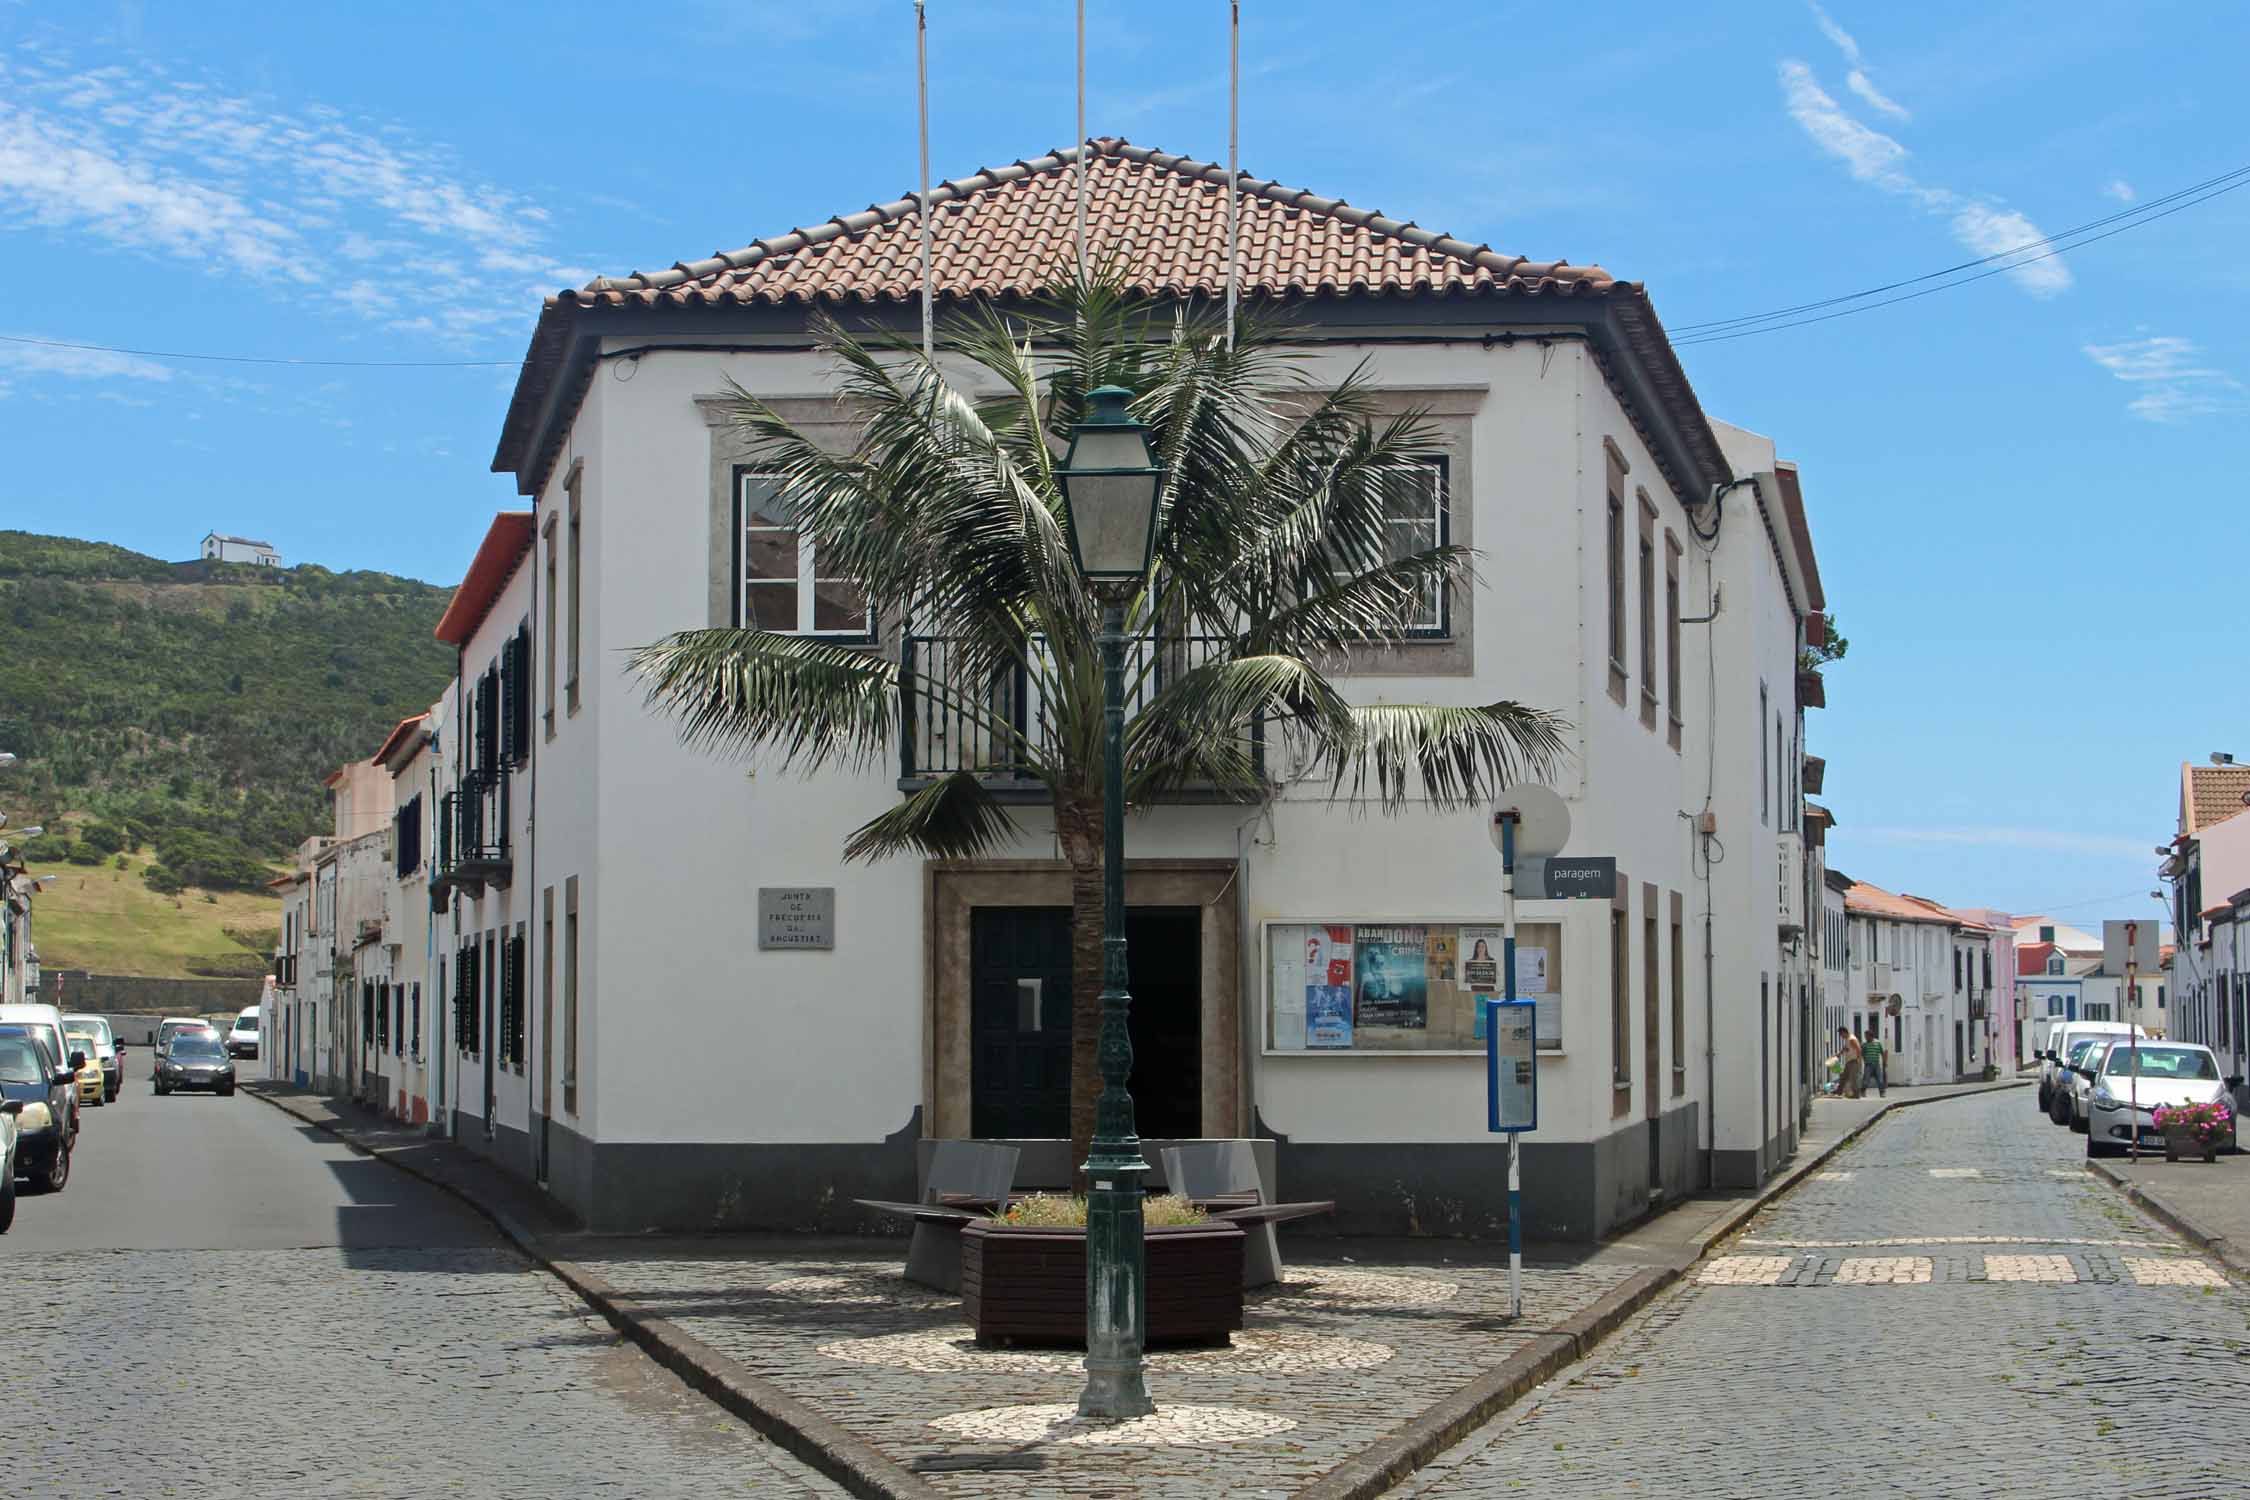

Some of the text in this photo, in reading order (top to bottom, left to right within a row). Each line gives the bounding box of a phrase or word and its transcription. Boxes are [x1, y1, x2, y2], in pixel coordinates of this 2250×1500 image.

[1554, 869, 1601, 881] paragem
[781, 892, 811, 900] JUNTA
[791, 903, 803, 911] DE
